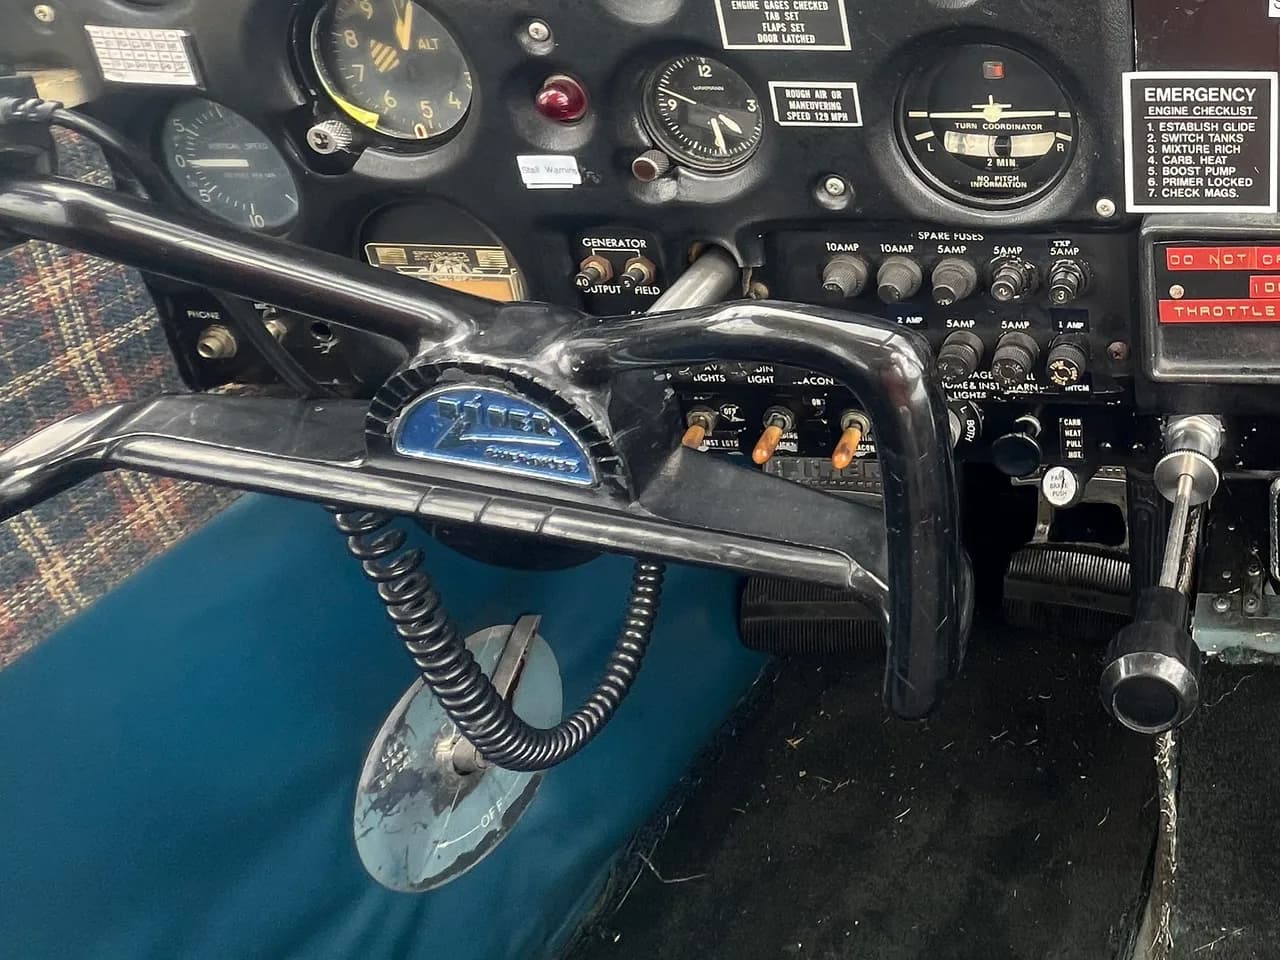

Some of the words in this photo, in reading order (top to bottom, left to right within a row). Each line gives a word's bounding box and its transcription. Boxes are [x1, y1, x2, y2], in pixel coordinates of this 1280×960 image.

[731, 1, 760, 9] ENGINE
[764, 1, 789, 10] GAGES
[793, 1, 828, 10] CHECKED
[764, 12, 780, 20] TAB
[785, 12, 799, 20] SET
[762, 23, 786, 32] FLAPS
[791, 24, 805, 32] SET
[757, 34, 778, 43] DOOR
[782, 34, 815, 43] LATCHED
[785, 89, 810, 98] ROUGH
[815, 90, 827, 99] AIR
[831, 91, 842, 99] OR
[1144, 88, 1256, 101] EMERGENCY
[789, 101, 841, 110] MANEUVERING
[1148, 106, 1188, 115] ENGINE
[1193, 107, 1253, 115] CHECKLIST
[787, 112, 810, 120] SPEED
[831, 113, 848, 121] MPH
[955, 122, 978, 130] TURN
[982, 123, 1042, 131] COORDINATOR
[1147, 123, 1154, 131] 1.
[1159, 123, 1218, 131] ESTABLISH
[1223, 123, 1255, 131] GLIDE
[1147, 134, 1156, 142] 2.
[1161, 134, 1203, 142] SWITCH
[1208, 134, 1244, 142] TANKS
[1147, 145, 1157, 153] 3.
[1162, 145, 1210, 153] MIXTURE
[1215, 145, 1240, 153] RICH
[987, 158, 992, 168] 2
[996, 159, 1016, 168] MIN
[1148, 156, 1158, 164] 4.
[1162, 156, 1195, 164] CARB.
[1200, 156, 1227, 164] HEAT
[1148, 167, 1157, 175] 5.
[1162, 167, 1201, 175] BOOST
[1205, 167, 1236, 175] PUMP
[1148, 178, 1158, 186] 6.
[1163, 178, 1203, 186] PRIMER
[1208, 178, 1252, 186] LOCKED
[1148, 189, 1157, 197] 7.
[1162, 189, 1200, 197] CHECK
[1204, 189, 1239, 197] MAGS.
[918, 231, 950, 241] SPARE
[582, 238, 646, 249] GENERATOR
[826, 242, 859, 252] 10AMP
[880, 243, 913, 253] 10AMP
[938, 245, 967, 254] 5AMP
[993, 245, 1022, 256] 5AMP
[1050, 246, 1079, 256] 5AMP
[1169, 254, 1194, 267] DO
[1209, 254, 1247, 267] NOT
[635, 285, 660, 296] FIELD
[1174, 305, 1276, 317] THROTTLE
